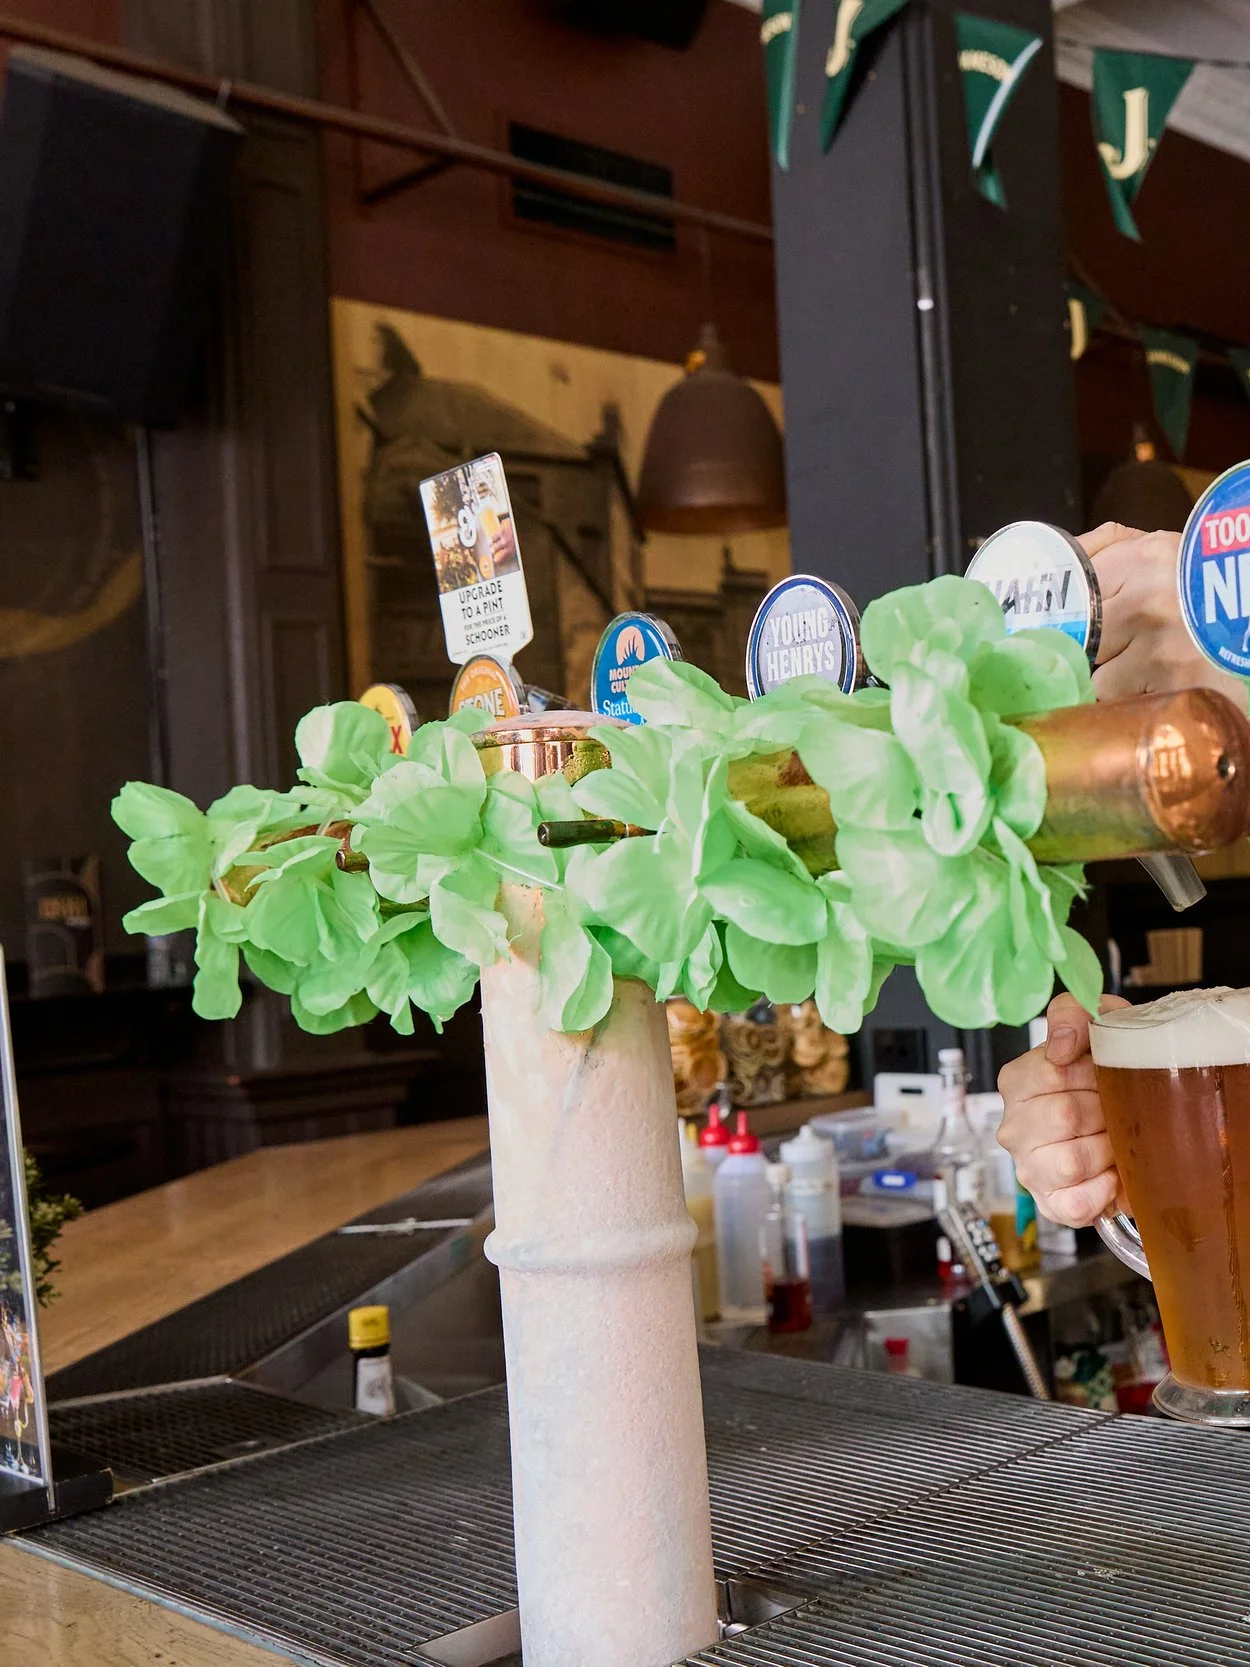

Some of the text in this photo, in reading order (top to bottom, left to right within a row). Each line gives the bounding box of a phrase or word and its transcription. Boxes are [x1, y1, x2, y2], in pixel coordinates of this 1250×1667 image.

[459, 580, 503, 604] UPGRADE
[462, 597, 503, 619] TO A PINT
[984, 569, 1072, 616] AHN
[466, 624, 510, 645] SCHOONER
[769, 606, 830, 648] YOUNG
[766, 640, 835, 682] HENRYS
